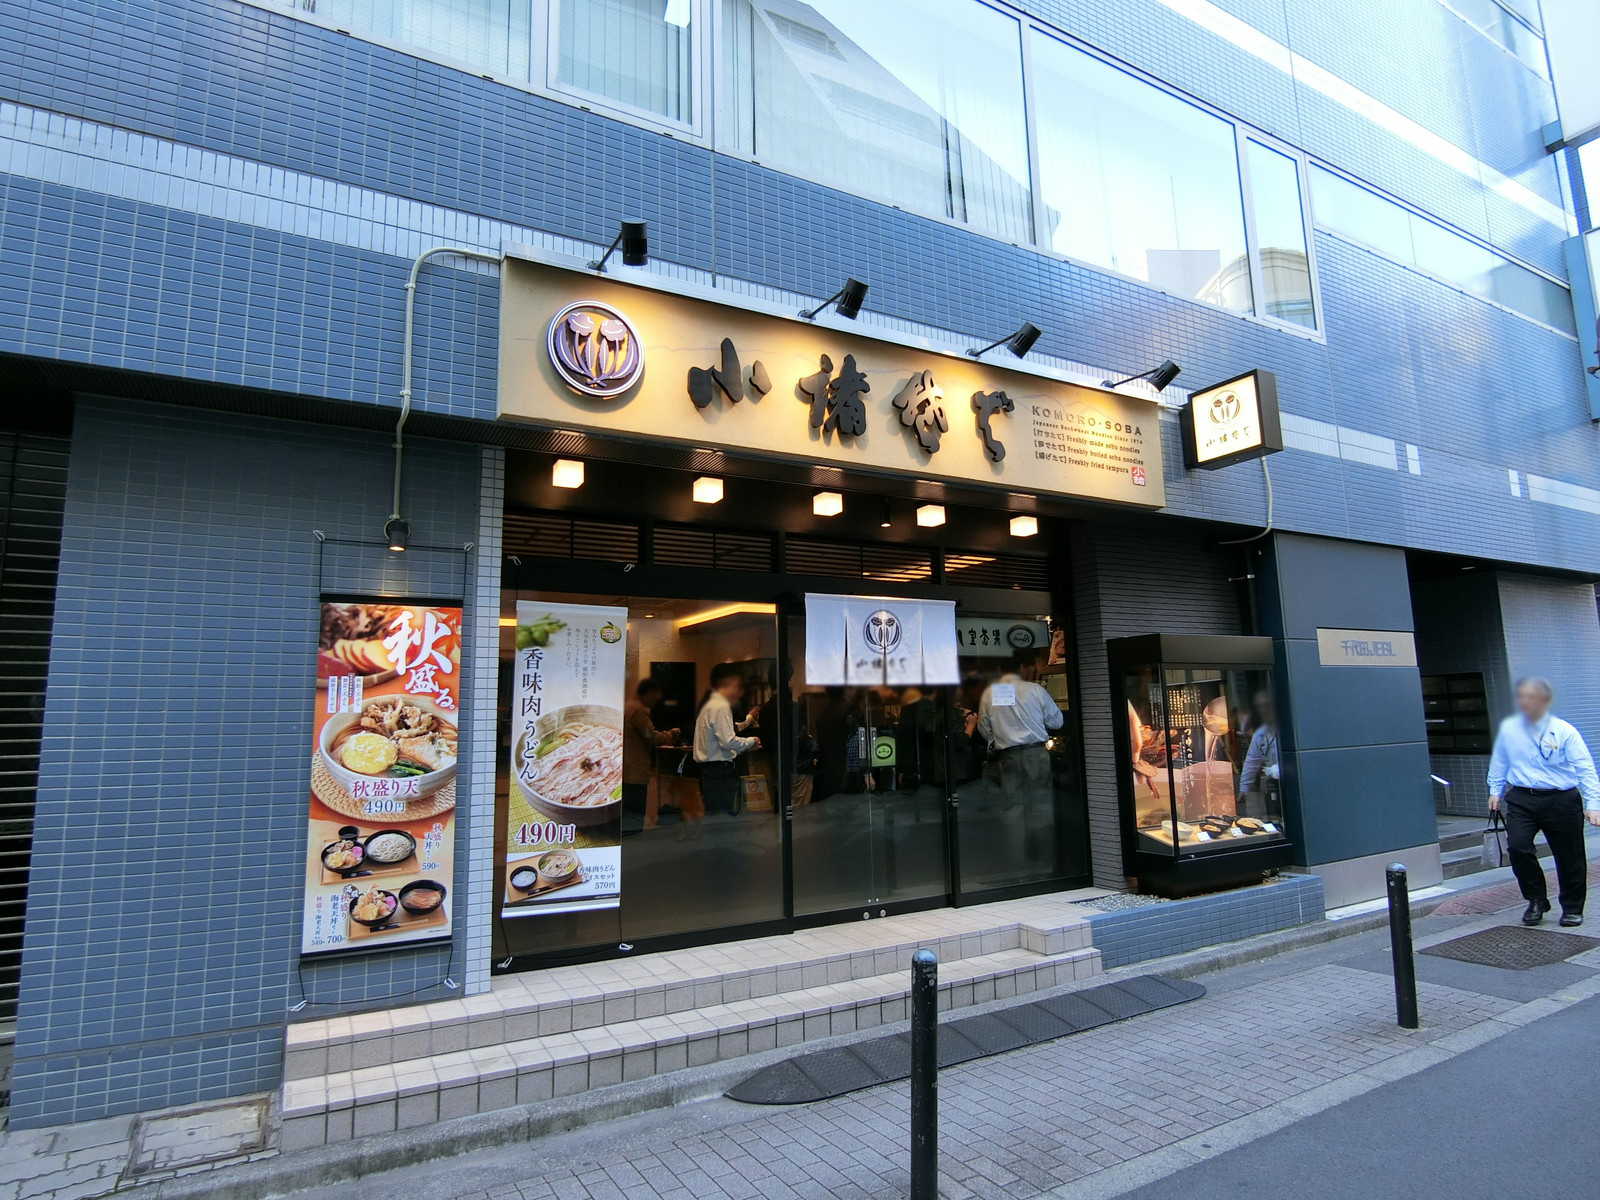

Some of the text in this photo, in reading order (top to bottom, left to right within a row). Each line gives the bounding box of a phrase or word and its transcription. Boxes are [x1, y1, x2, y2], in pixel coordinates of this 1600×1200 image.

[1032, 419, 1059, 429] Japanese
[1130, 438, 1144, 446] 1974
[1066, 435, 1088, 445] Freshly
[1089, 440, 1104, 448] made
[1105, 442, 1118, 451] soba
[1119, 444, 1141, 455] noodles
[1067, 446, 1089, 457] Freshly
[1090, 451, 1108, 460] boiled
[1108, 453, 1121, 462] soba
[1122, 456, 1144, 466] noodles
[1068, 457, 1090, 468] Freshly
[1090, 461, 1105, 470] fried
[1105, 464, 1129, 475] tempura
[519, 647, 543, 780] 香味肉うどん
[351, 778, 420, 799] 秋盛り天
[363, 799, 406, 814] 490円
[515, 822, 576, 845] 490円
[579, 864, 616, 873] 香味肉うどん
[594, 881, 616, 889] 570円
